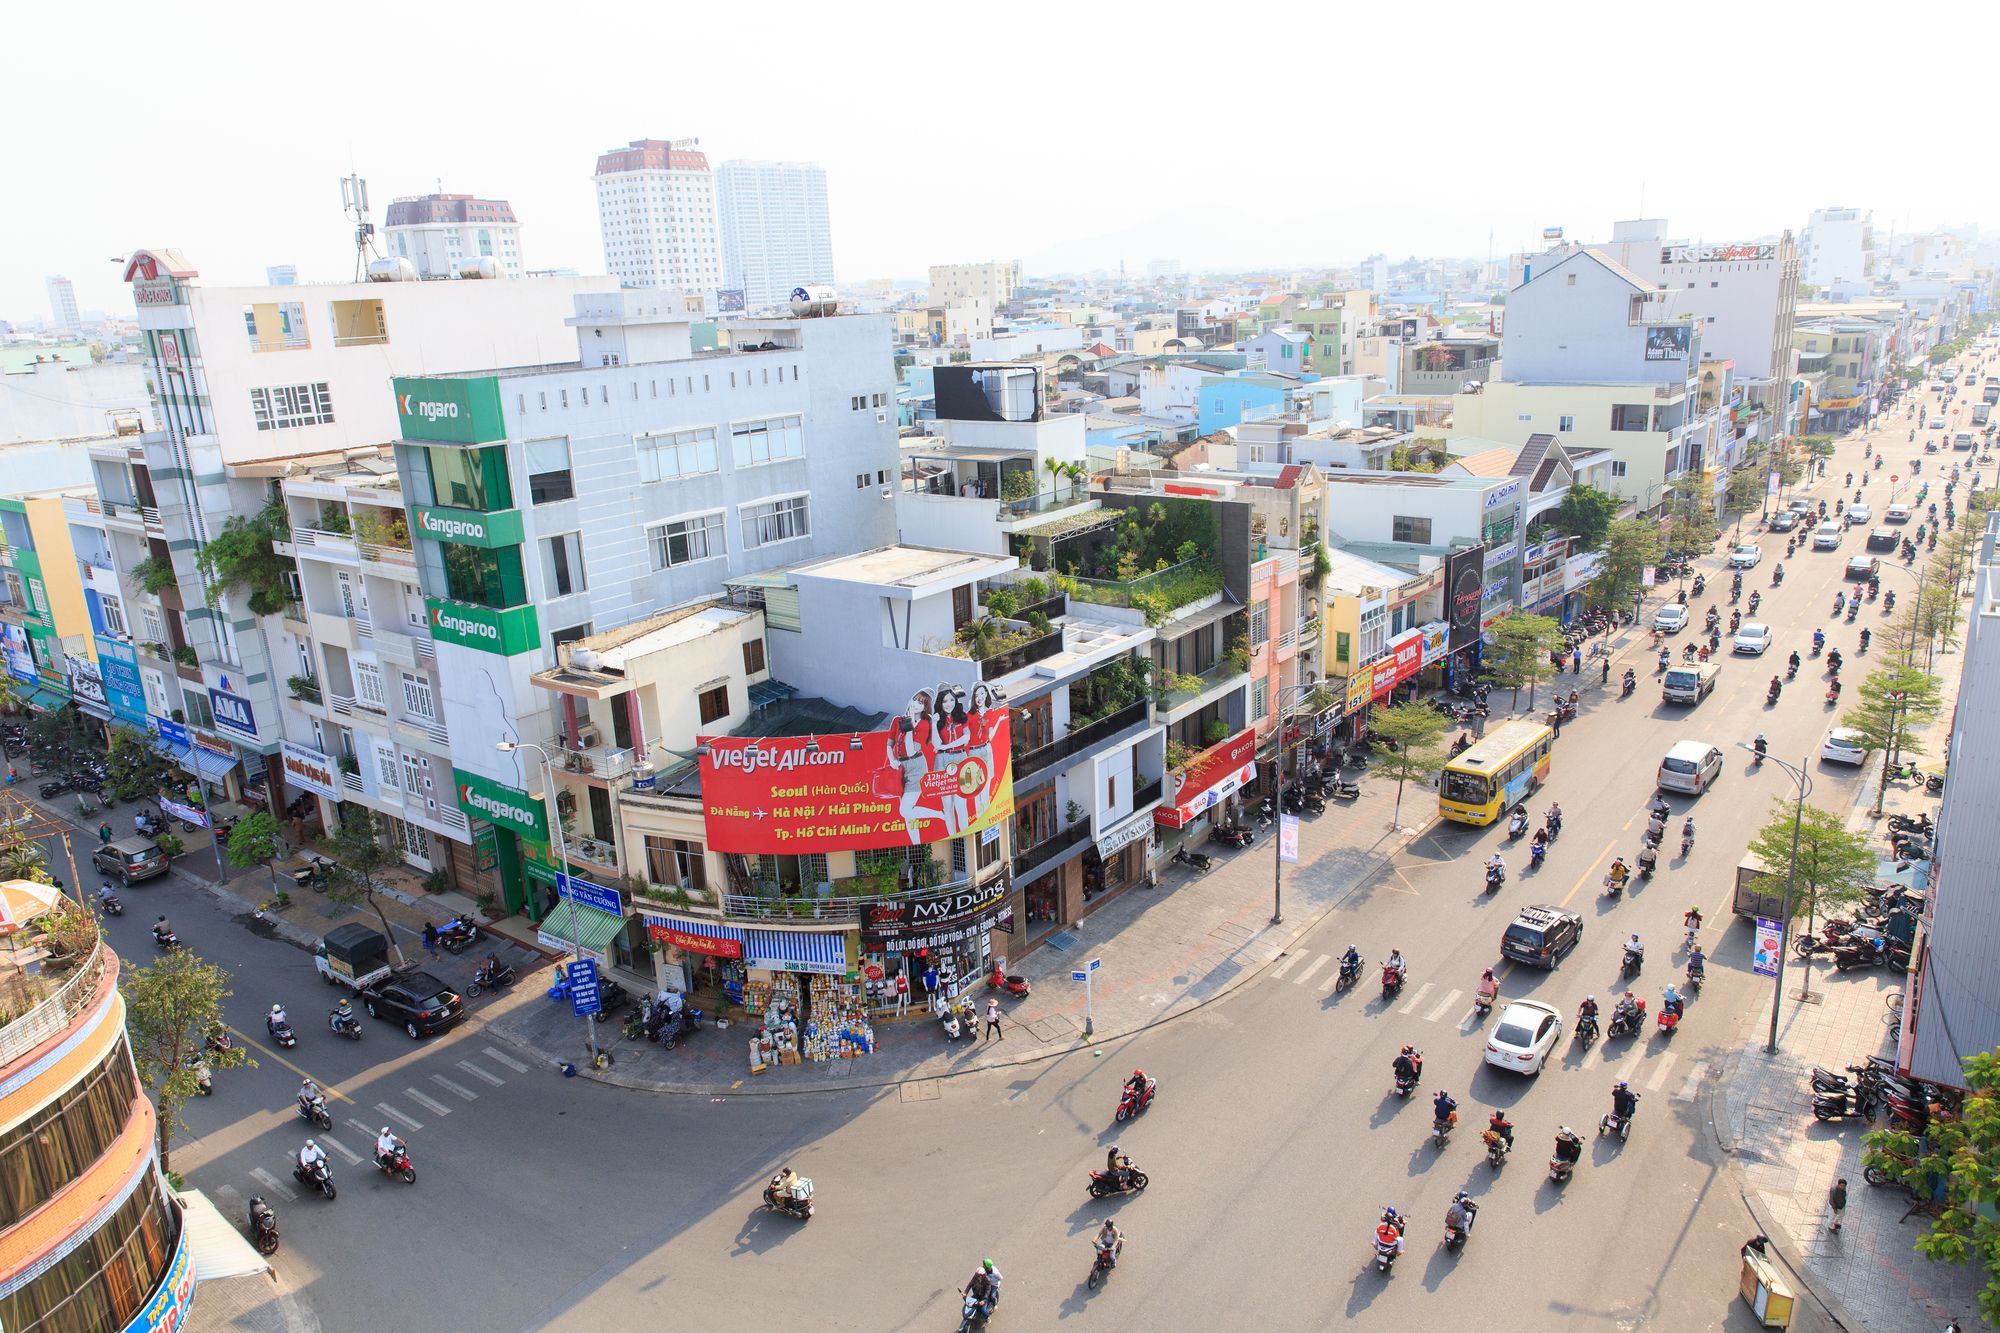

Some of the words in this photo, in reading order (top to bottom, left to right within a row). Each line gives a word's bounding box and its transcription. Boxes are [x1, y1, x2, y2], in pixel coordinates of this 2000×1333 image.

[417, 511, 484, 538] Kangaroo
[431, 607, 497, 640] Kangaroo
[770, 785, 808, 799] Seoul
[811, 785, 837, 797] (Hàn
[839, 782, 869, 797] Quốc)
[460, 784, 535, 826] Kangaroo
[710, 806, 724, 817] Đà
[725, 805, 750, 820] Nẵng
[772, 804, 791, 819] Hà
[793, 804, 815, 821] Nội
[828, 801, 850, 816] Hải
[853, 801, 892, 815] Phòng
[775, 828, 794, 841] Tp.
[796, 825, 816, 838] Hồ
[816, 824, 837, 837] Chí
[840, 823, 871, 835] Minh
[881, 819, 906, 832] Cần
[908, 819, 931, 830] Thơ
[580, 889, 593, 901] VĂN
[593, 895, 617, 909] CƯỜNG
